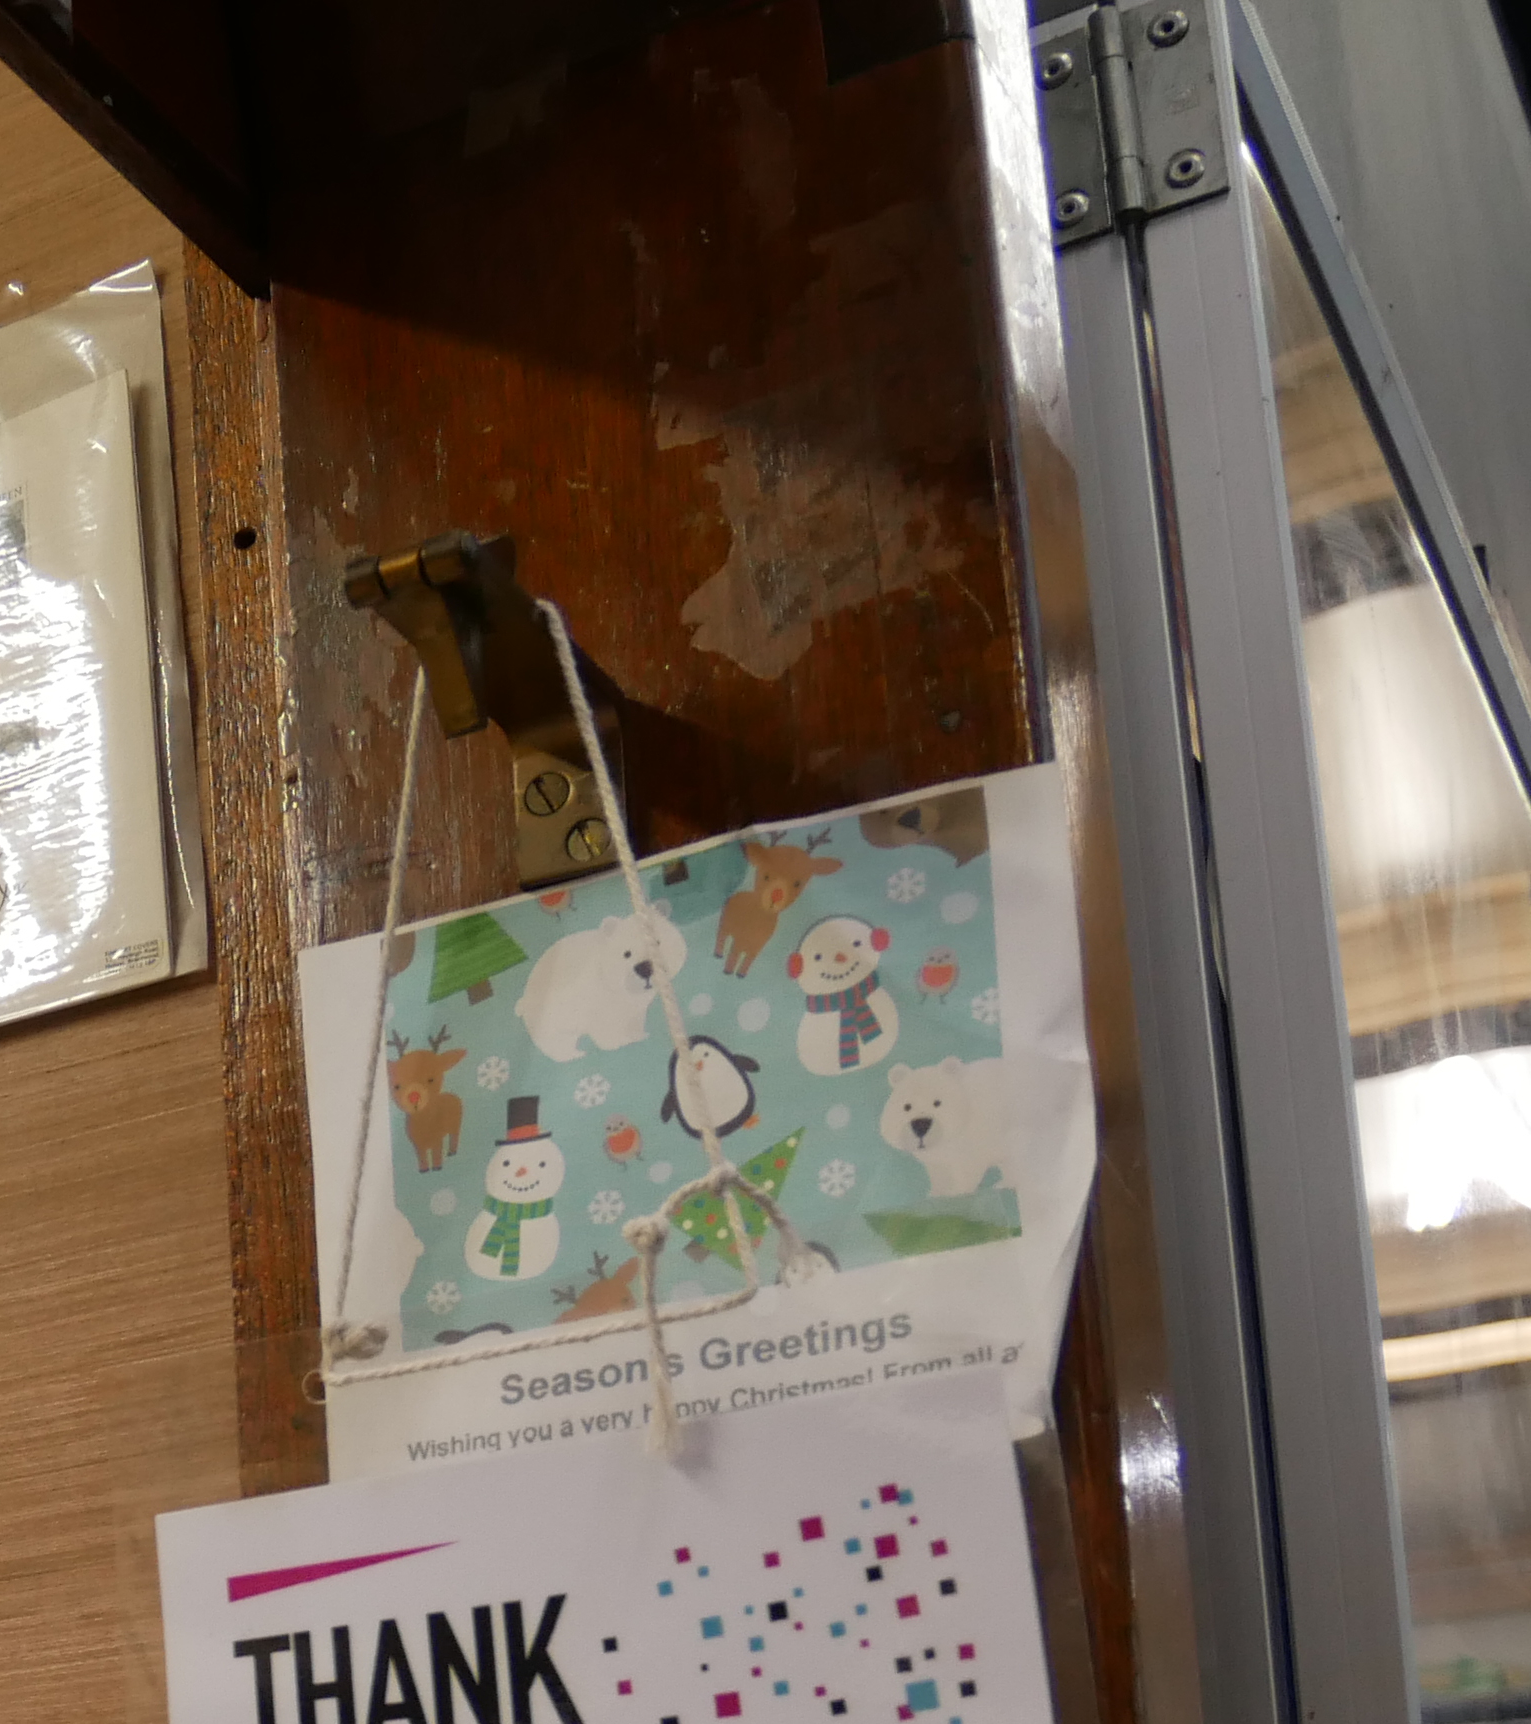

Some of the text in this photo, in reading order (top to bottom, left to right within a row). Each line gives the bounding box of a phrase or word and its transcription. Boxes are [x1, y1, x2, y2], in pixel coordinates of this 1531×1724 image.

[699, 1308, 914, 1374] Greetings
[407, 1428, 503, 1463] Wishing
[507, 1416, 553, 1450] you
[560, 1420, 575, 1439] a
[580, 1407, 634, 1440] very
